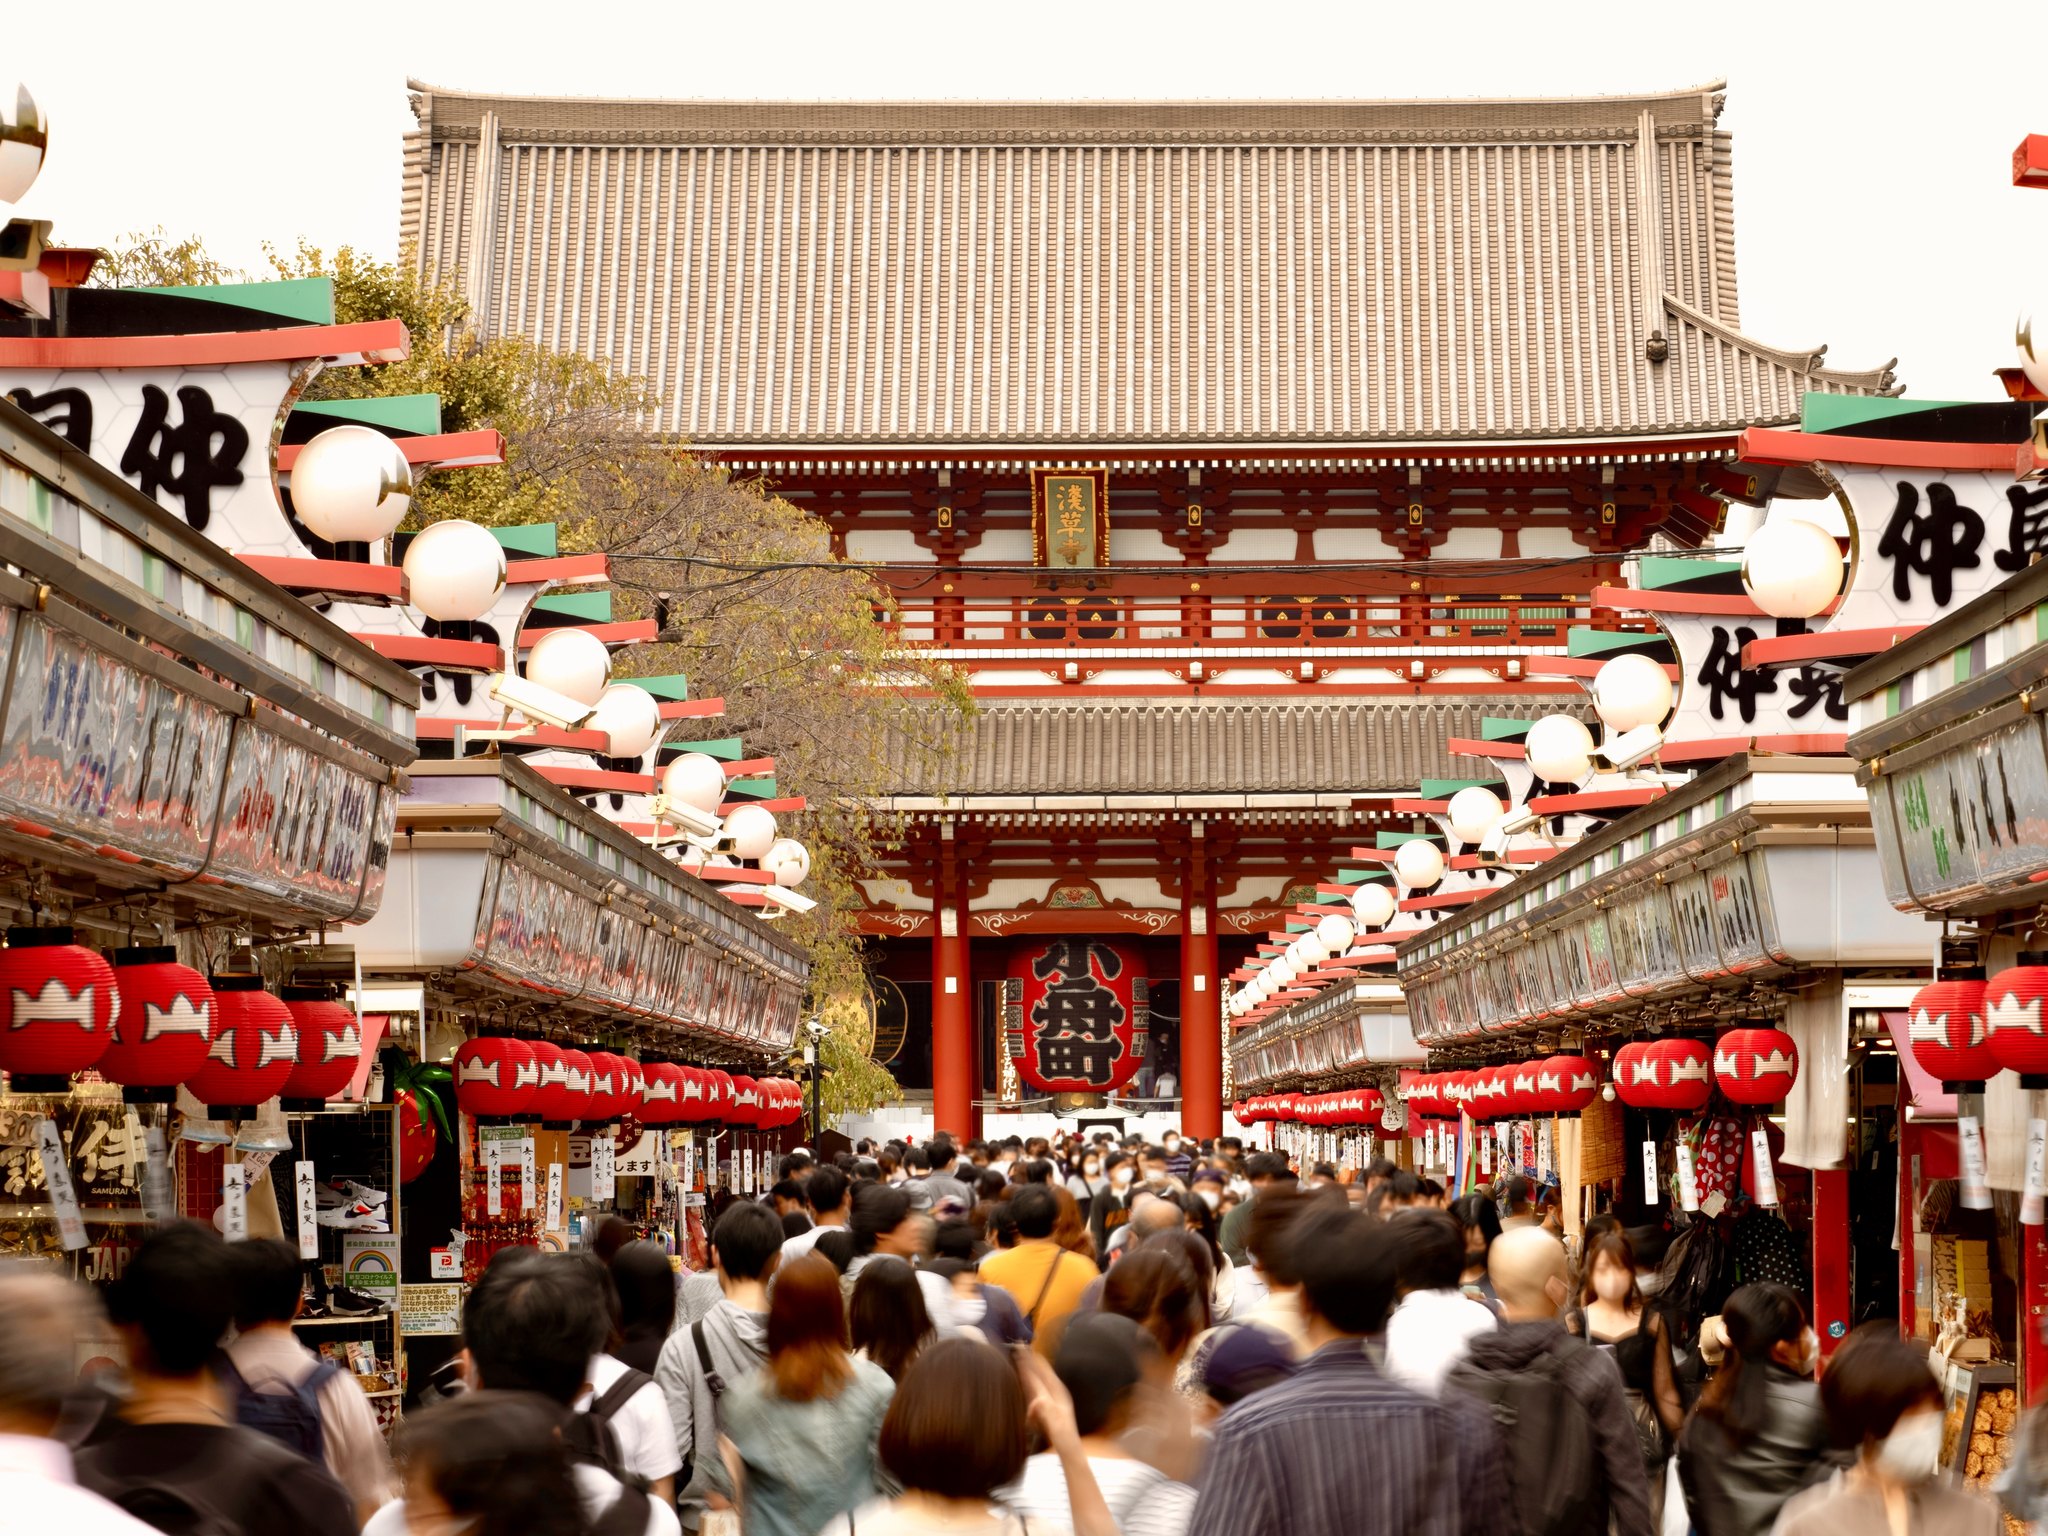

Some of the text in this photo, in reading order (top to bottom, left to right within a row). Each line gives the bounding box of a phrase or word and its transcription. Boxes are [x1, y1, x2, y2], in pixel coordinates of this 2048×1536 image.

[1031, 939, 1127, 1085] 小舟町
[91, 1187, 129, 1195] SAMURAI
